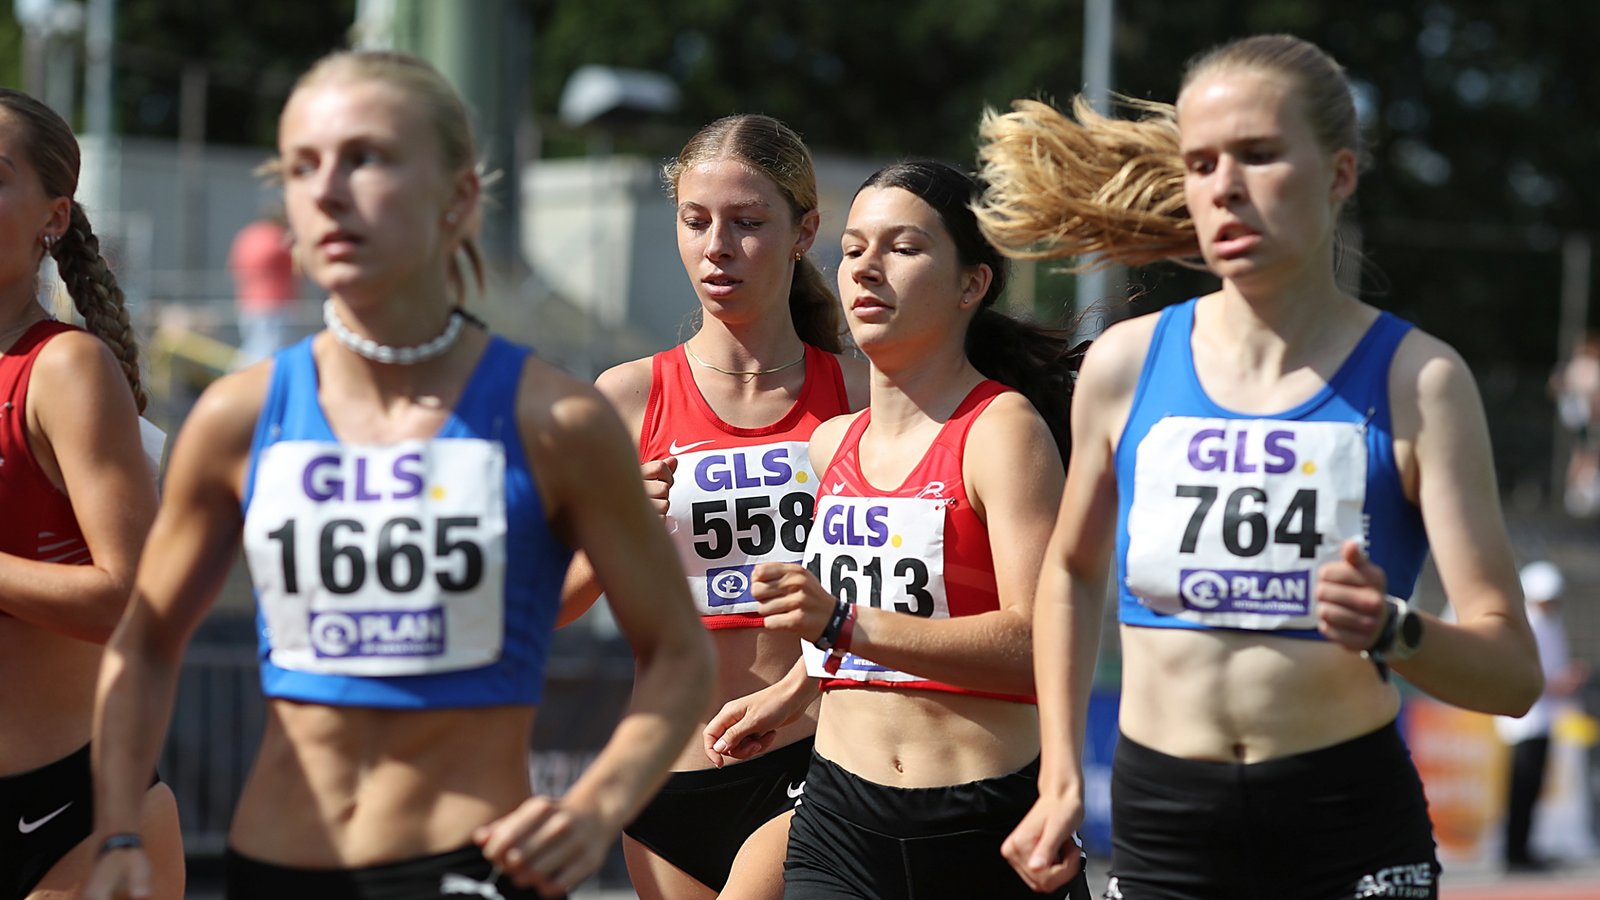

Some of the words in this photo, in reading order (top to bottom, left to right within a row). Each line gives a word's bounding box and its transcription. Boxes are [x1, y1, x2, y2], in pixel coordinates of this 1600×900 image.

[267, 517, 484, 595] 1665
[692, 492, 815, 559] 558
[1176, 485, 1323, 558] 764
[1231, 577, 1305, 600] PLAN
